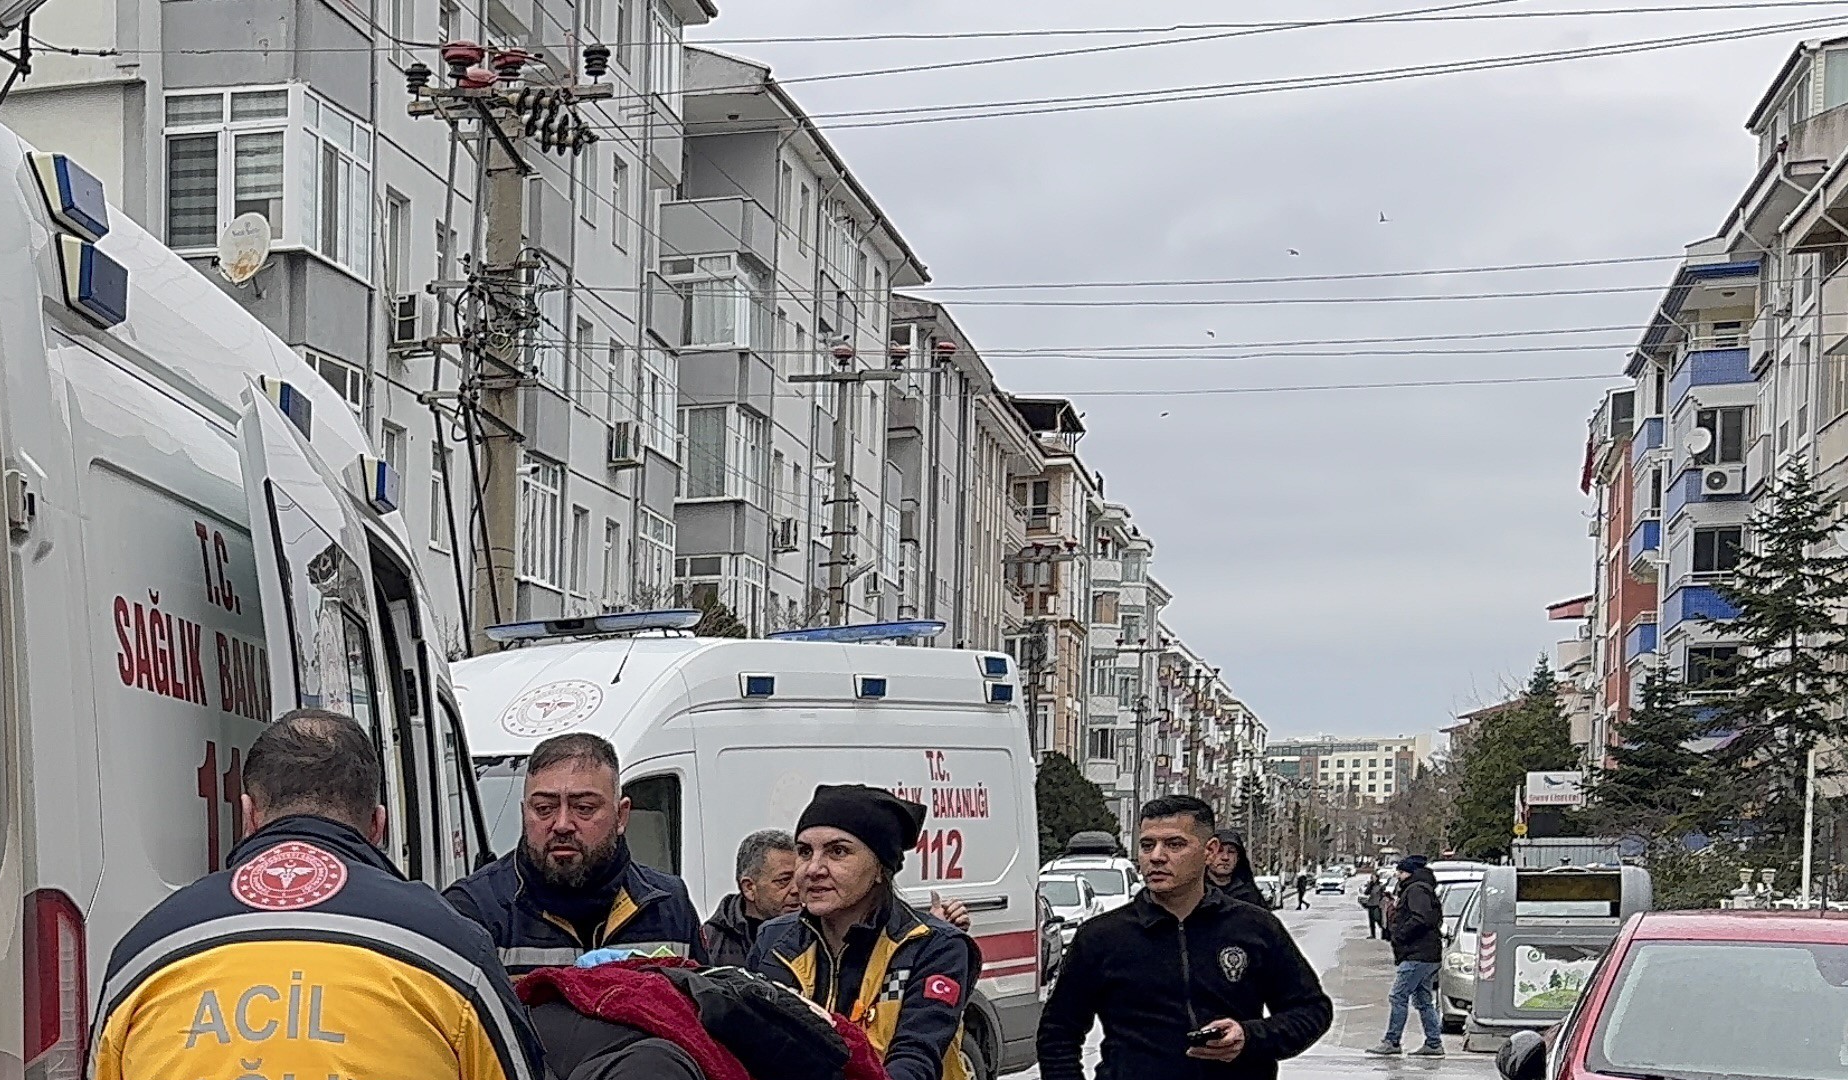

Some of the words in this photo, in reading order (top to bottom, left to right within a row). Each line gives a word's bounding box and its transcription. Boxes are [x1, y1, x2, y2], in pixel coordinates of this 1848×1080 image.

[194, 519, 241, 615] T.C.
[114, 587, 208, 707] SAĞLIK
[925, 750, 951, 782] T.C.
[932, 781, 990, 819] BAKANLIĞI
[915, 829, 963, 881] 112
[181, 970, 346, 1049] ACİL
